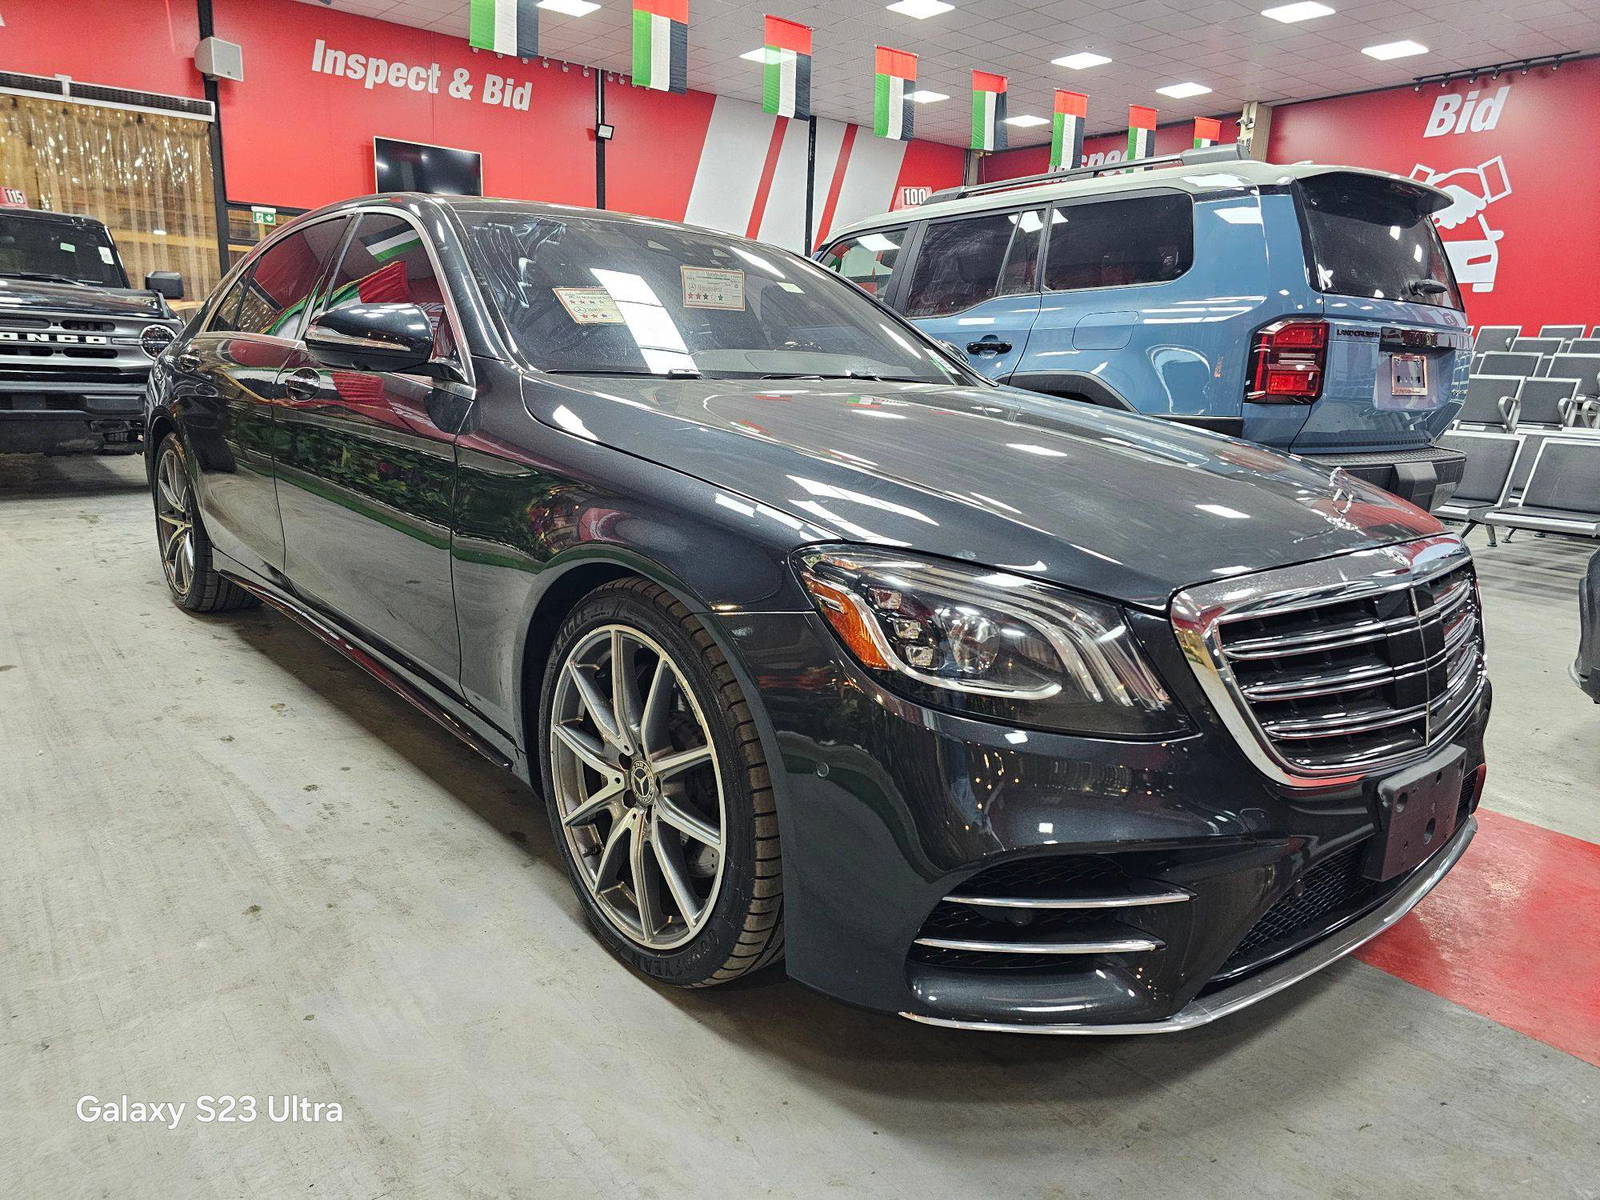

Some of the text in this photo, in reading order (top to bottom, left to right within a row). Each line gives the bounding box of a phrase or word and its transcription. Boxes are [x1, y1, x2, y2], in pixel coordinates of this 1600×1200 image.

[311, 38, 533, 111] Inspect & Bid
[1423, 86, 1511, 138] Bid
[5, 188, 25, 204] 115
[904, 188, 927, 205] 100
